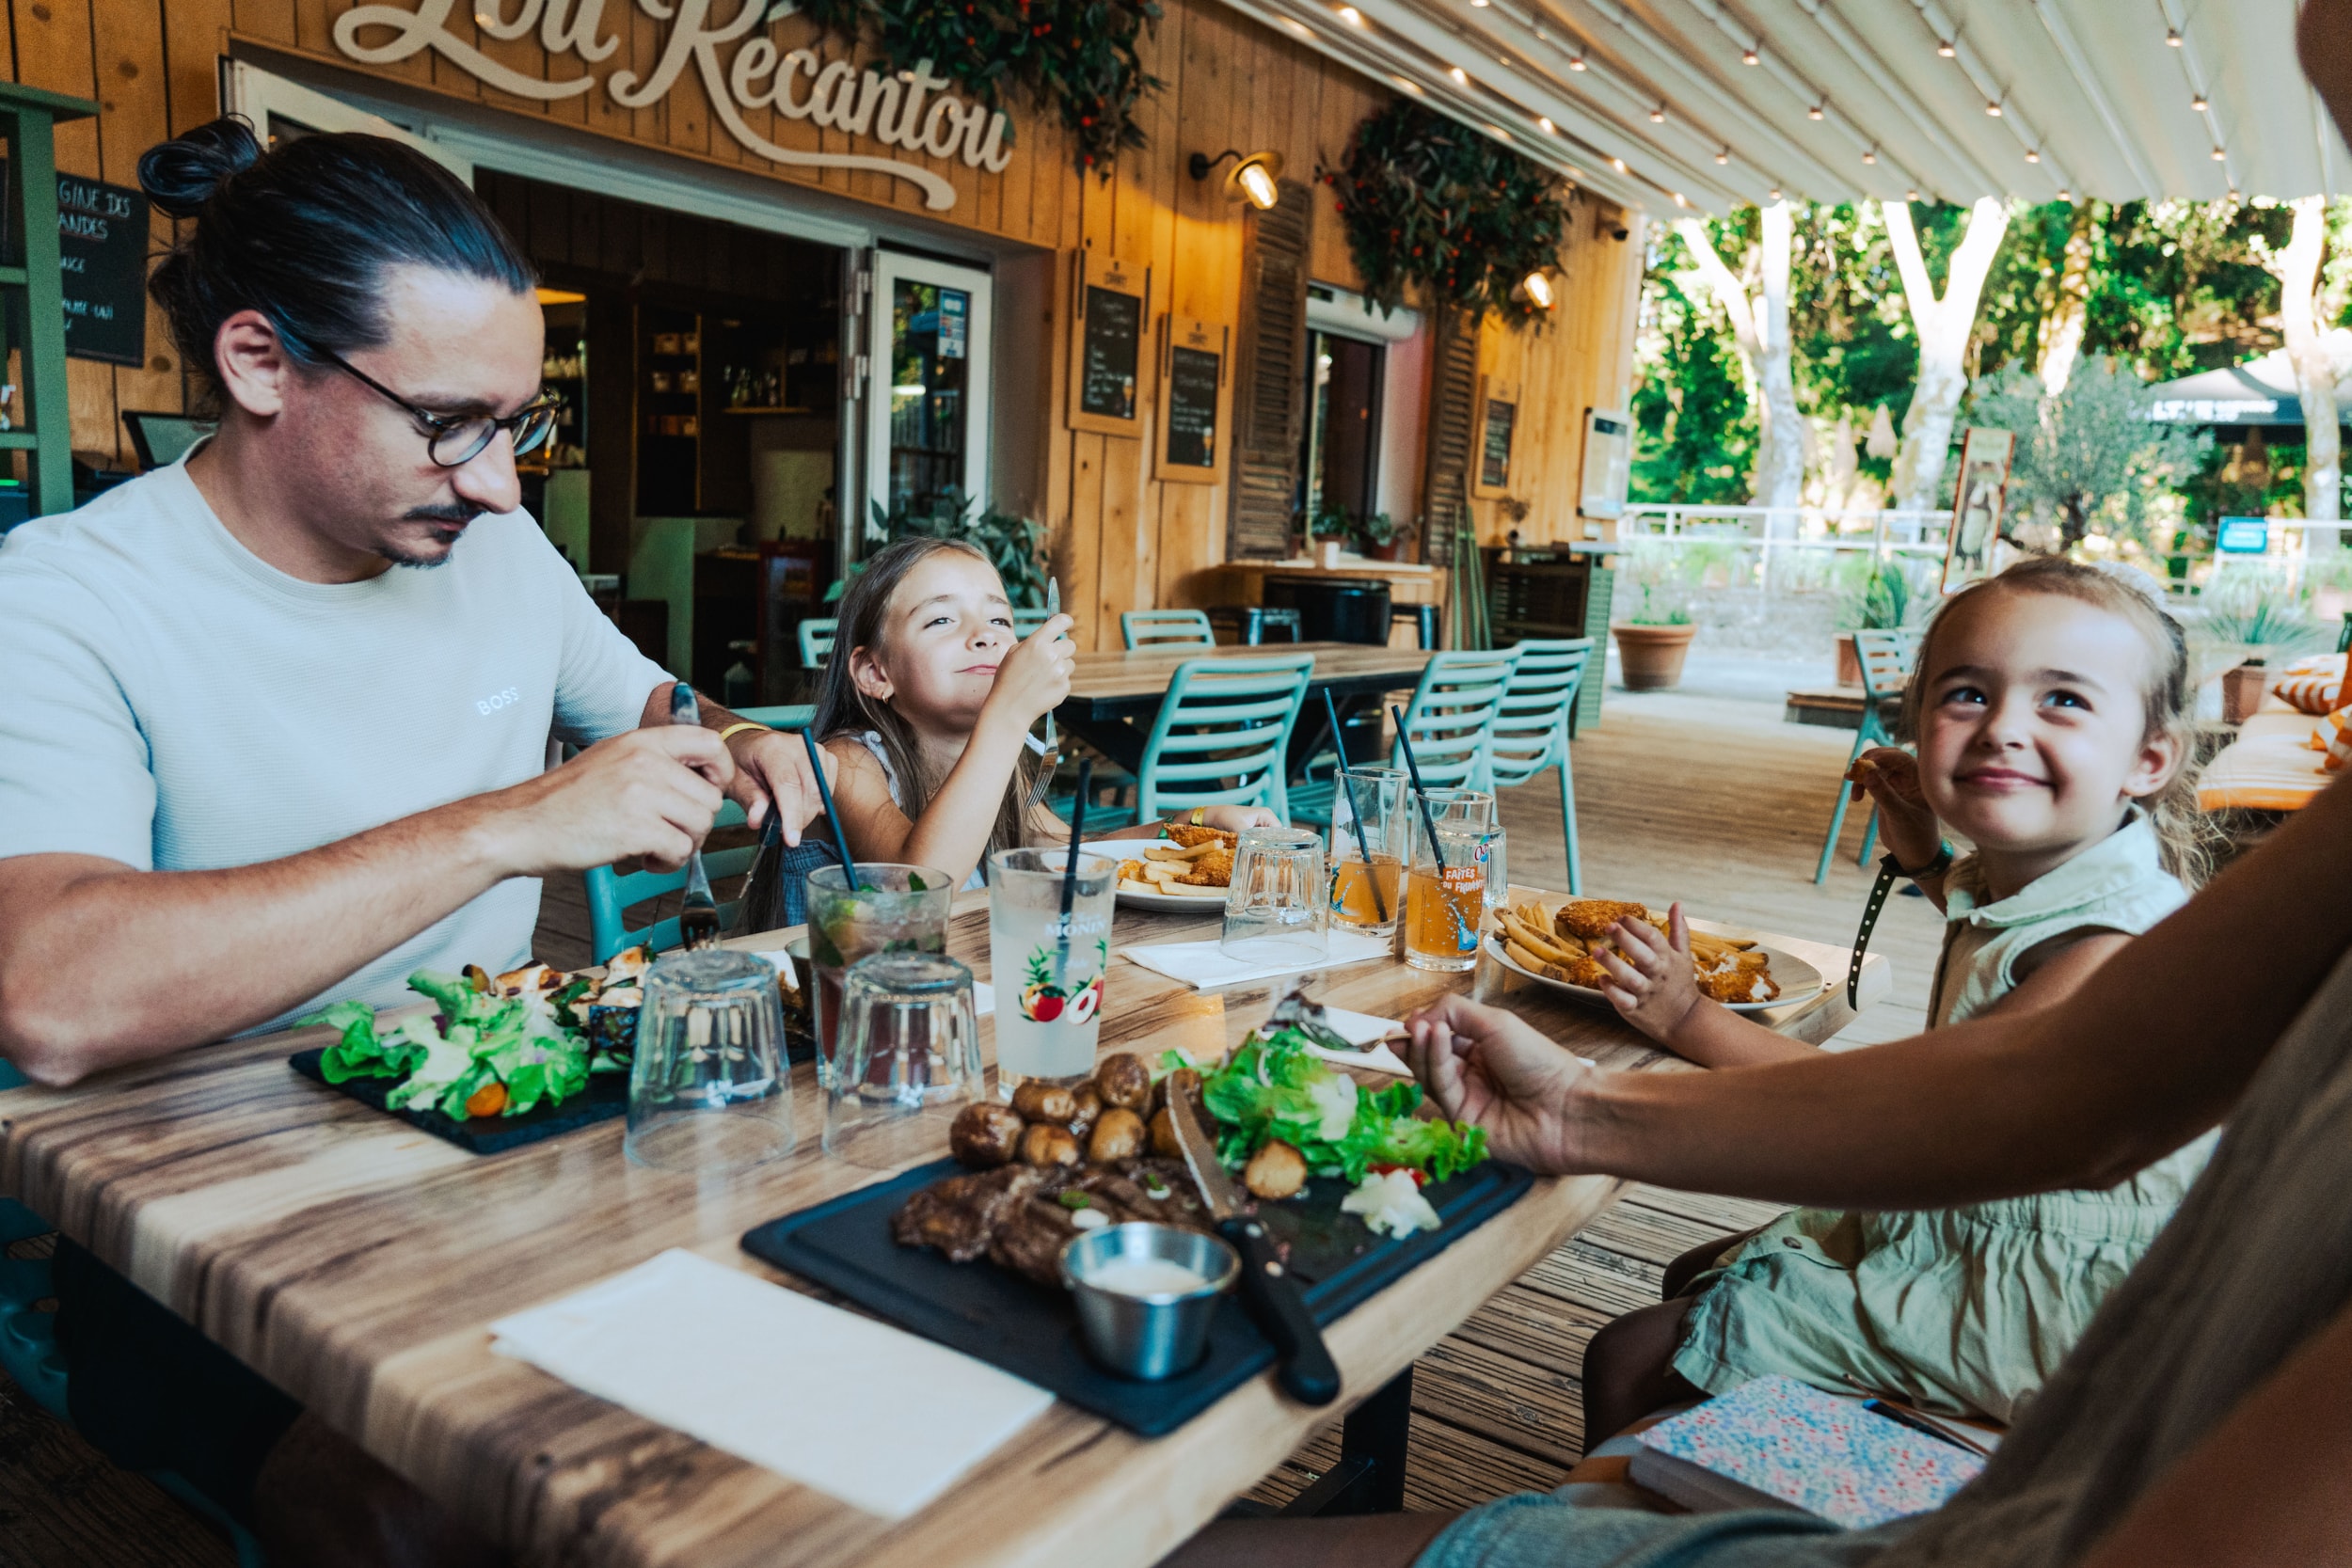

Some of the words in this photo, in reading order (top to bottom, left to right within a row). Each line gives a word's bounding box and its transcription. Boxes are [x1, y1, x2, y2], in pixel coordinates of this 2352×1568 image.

[58, 180, 101, 212] GINE
[58, 212, 108, 240] ANDES
[476, 687, 519, 716] BOSS
[1044, 919, 1107, 938] MONIN
